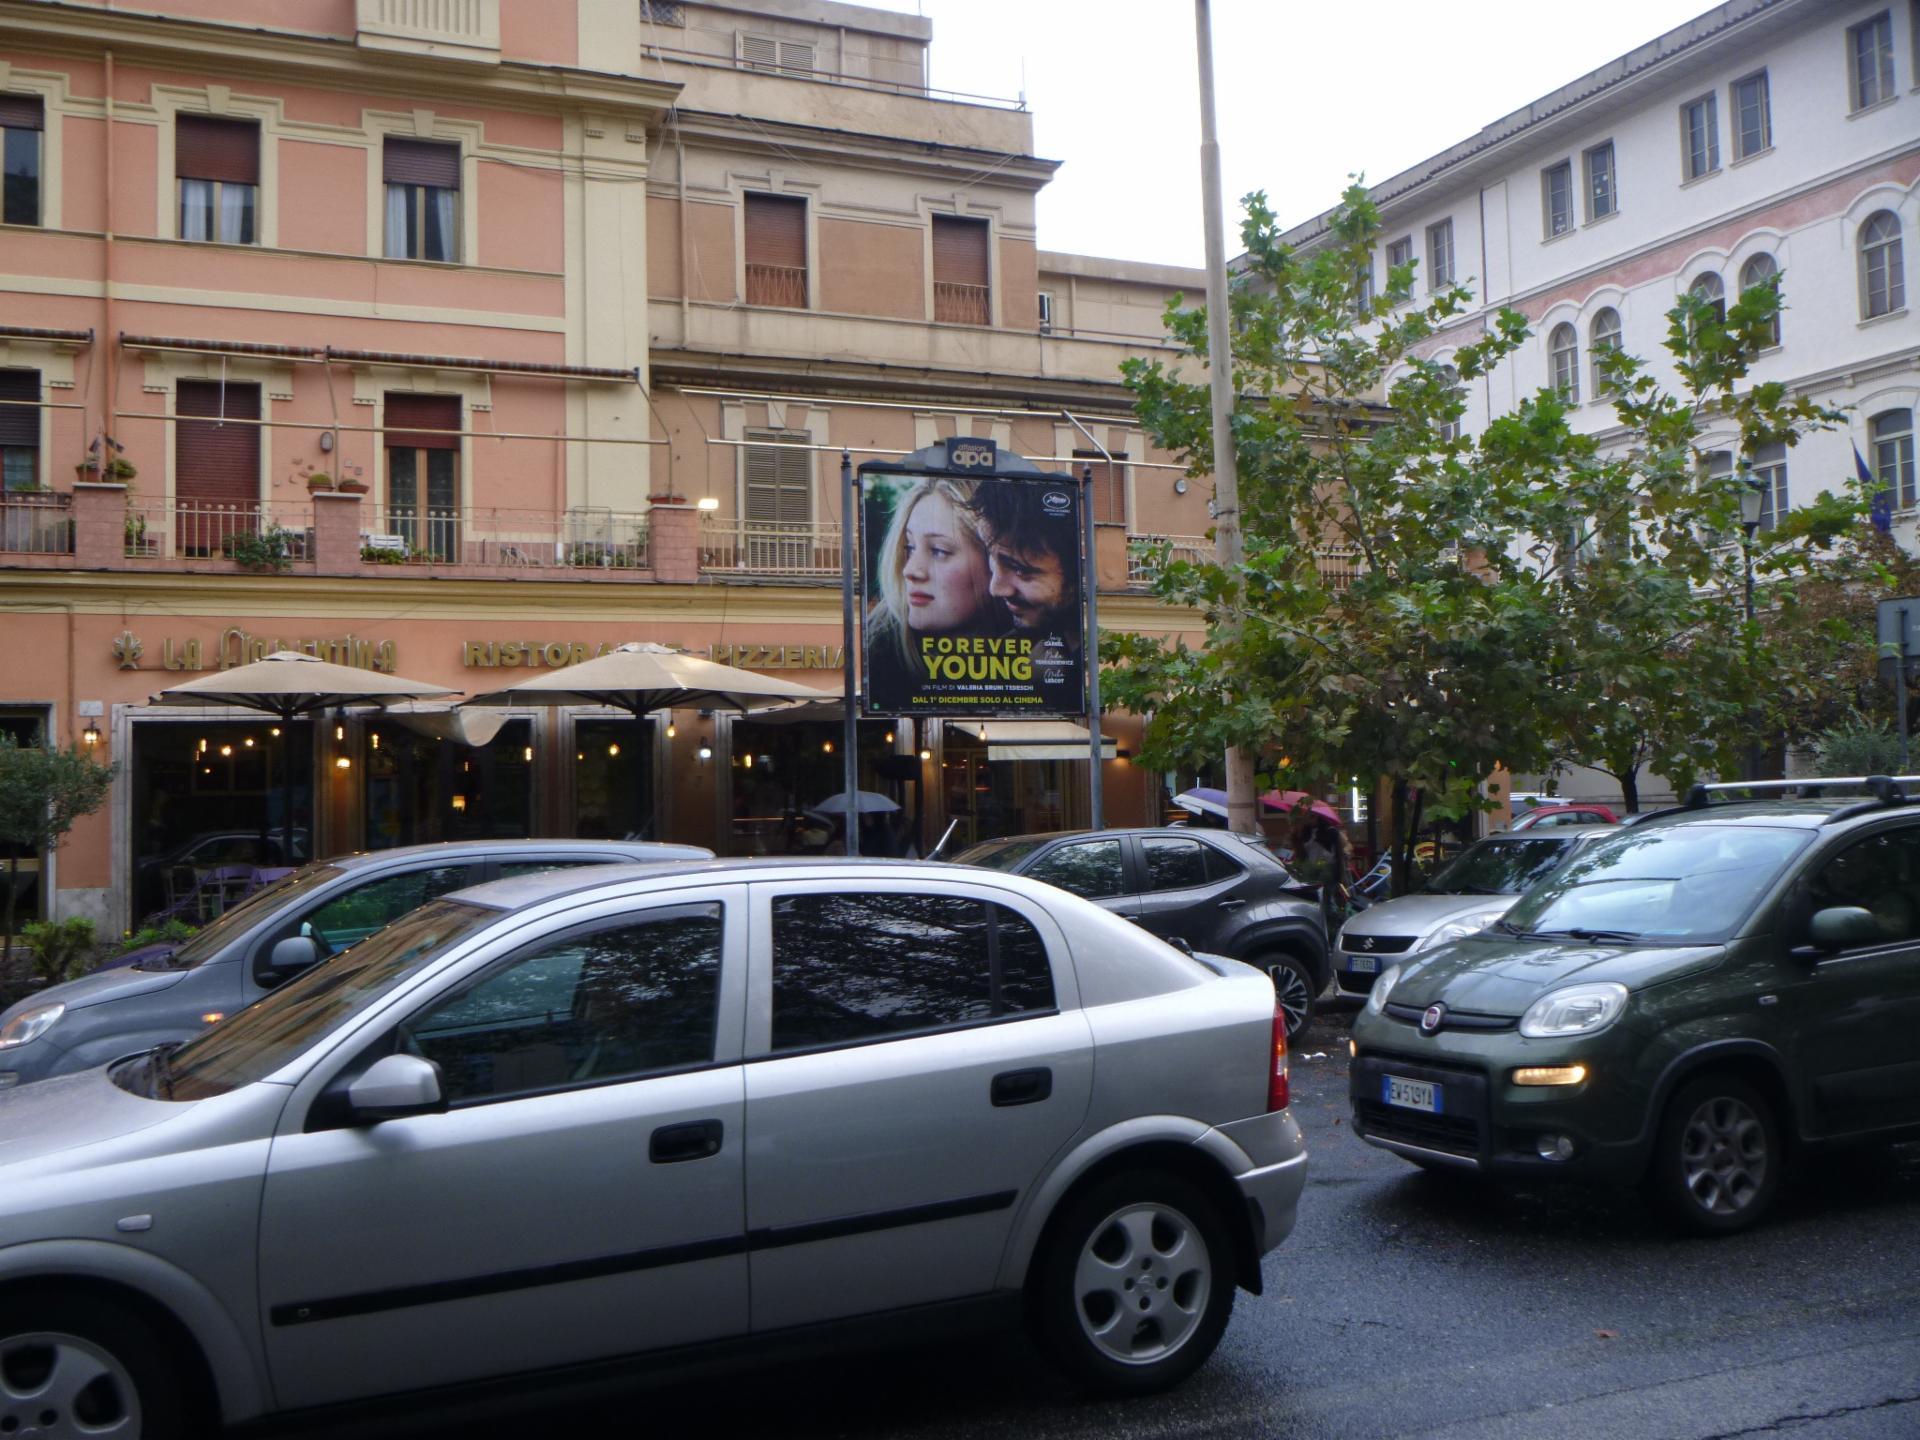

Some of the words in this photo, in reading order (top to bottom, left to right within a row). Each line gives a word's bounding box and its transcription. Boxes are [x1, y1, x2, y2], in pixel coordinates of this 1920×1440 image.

[952, 450, 993, 468] apa
[163, 637, 202, 671] LA
[463, 640, 683, 668] RISTORA
[922, 638, 1032, 654] FOREVER
[922, 655, 1033, 680] YOUNG
[912, 696, 928, 704] DAL
[938, 696, 978, 704] DICEMBRE
[980, 696, 1000, 704] SOLO
[1002, 696, 1013, 704] AL
[1014, 696, 1044, 704] CINEMA
